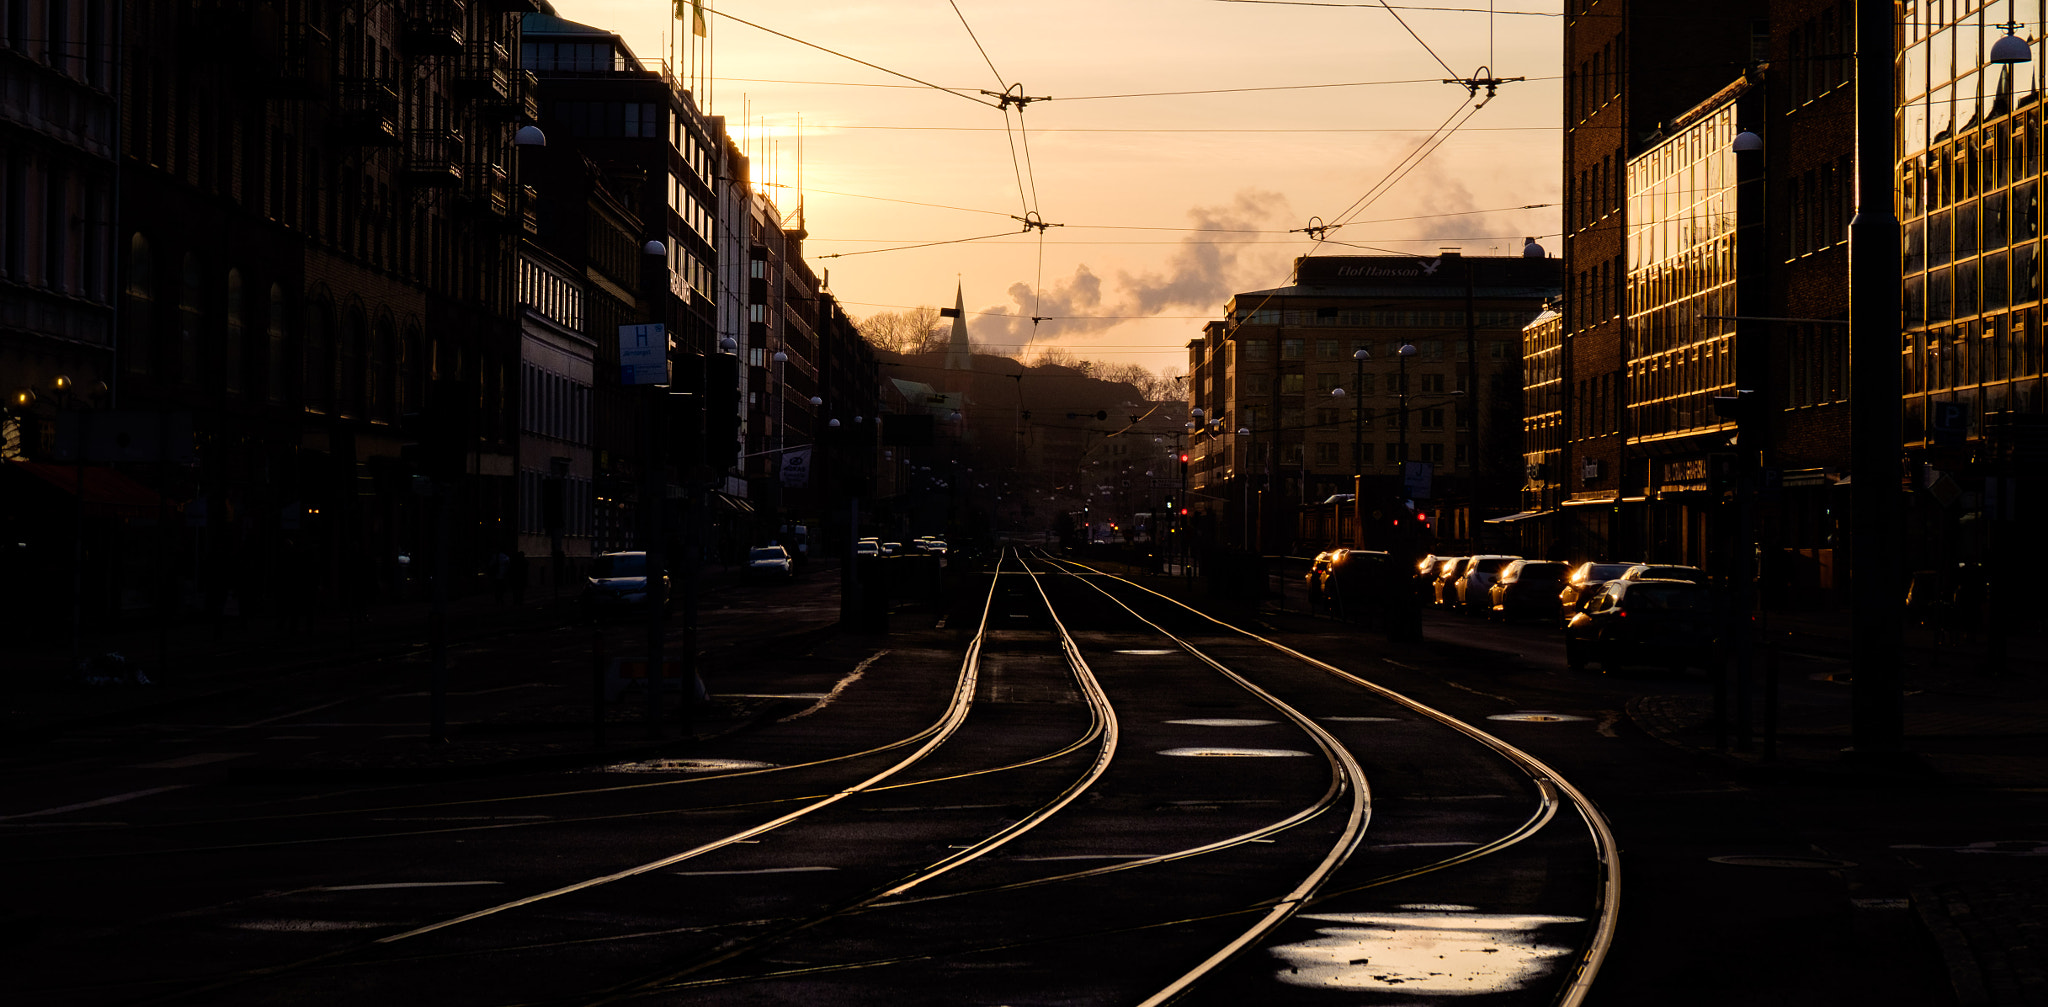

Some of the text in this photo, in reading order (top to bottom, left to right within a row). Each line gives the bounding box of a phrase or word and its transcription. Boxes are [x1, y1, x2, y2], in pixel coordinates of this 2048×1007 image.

[1337, 265, 1420, 277] Elof Hansson
[635, 325, 648, 347] H
[1945, 405, 1961, 427] P
